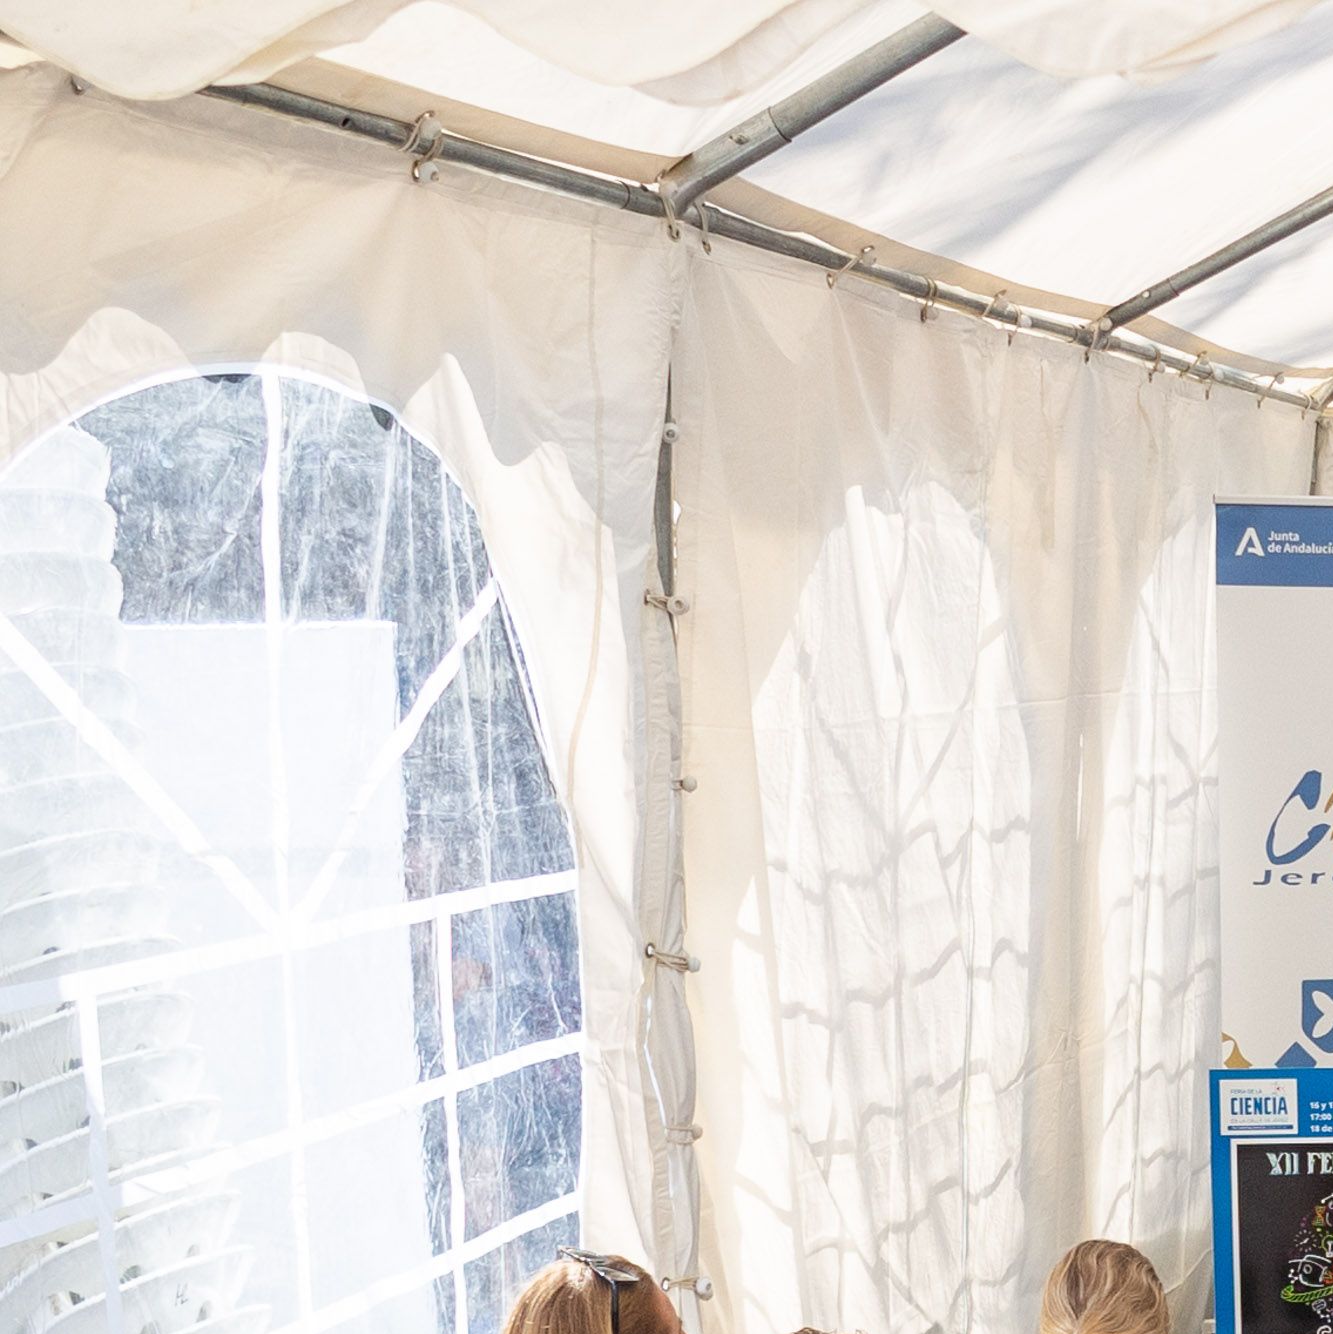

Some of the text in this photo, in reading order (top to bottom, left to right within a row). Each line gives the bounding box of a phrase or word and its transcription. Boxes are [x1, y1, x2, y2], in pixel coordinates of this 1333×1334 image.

[1268, 531, 1300, 542] Junta
[1267, 542, 1282, 553] de
[1230, 1096, 1288, 1115] CIENCIA
[1321, 1124, 1332, 1132] de
[1266, 1152, 1300, 1176] XII
